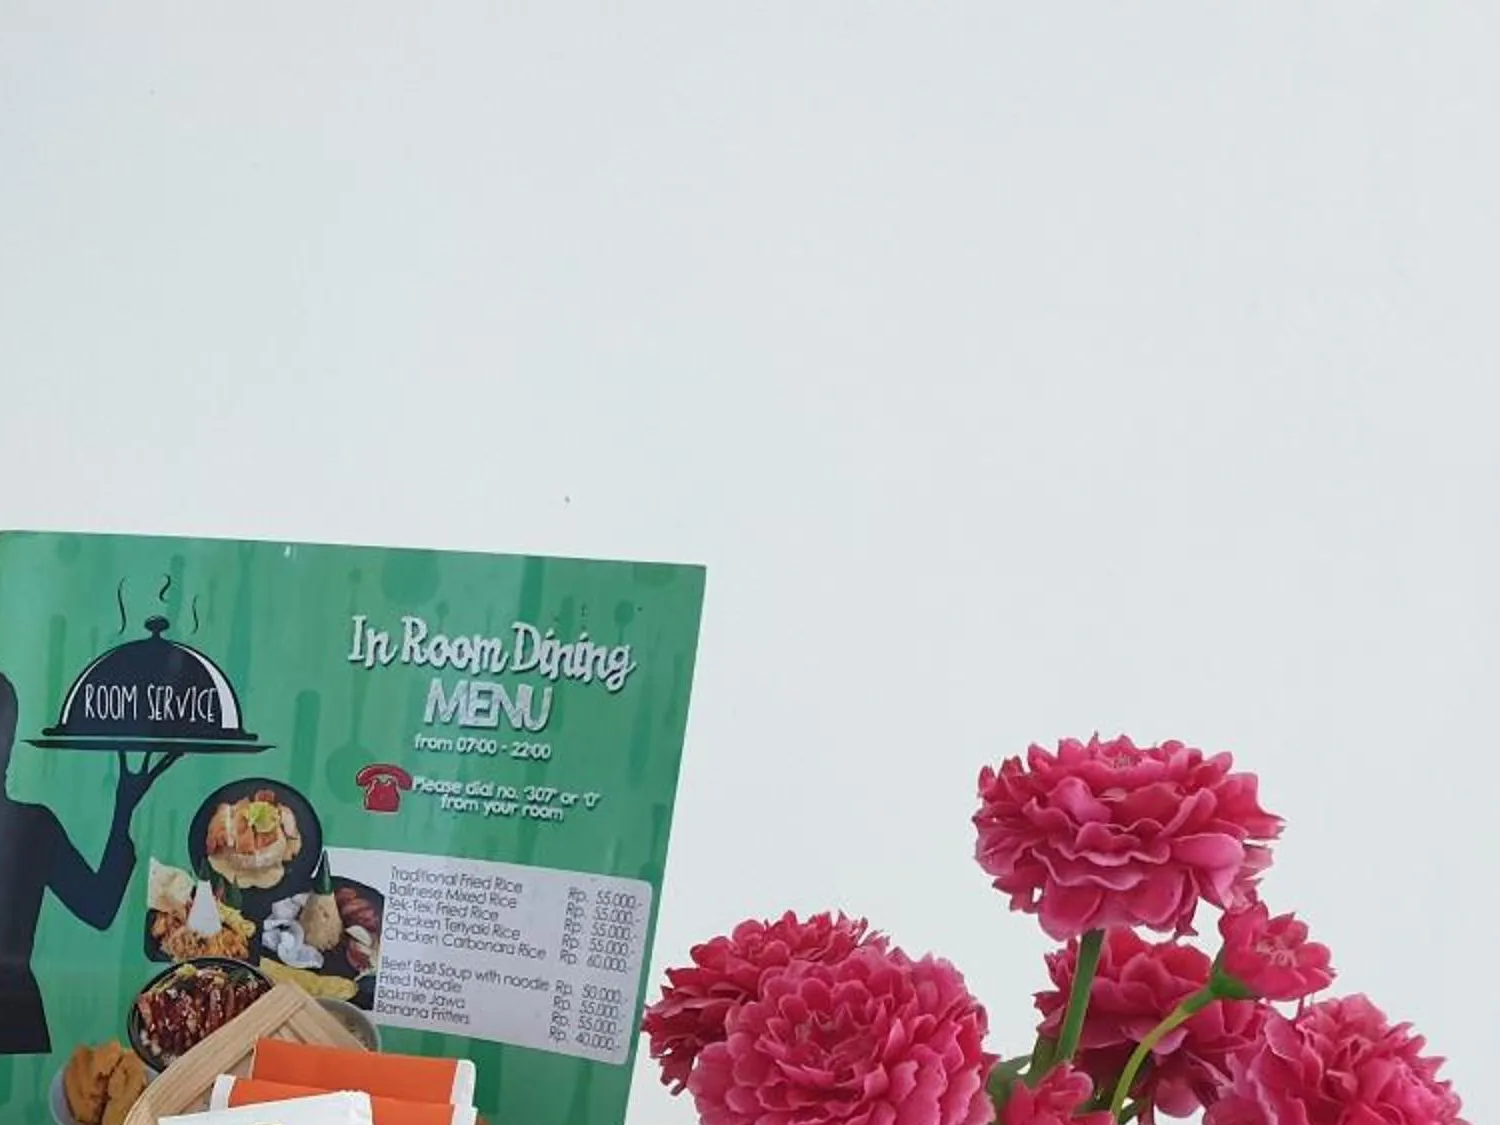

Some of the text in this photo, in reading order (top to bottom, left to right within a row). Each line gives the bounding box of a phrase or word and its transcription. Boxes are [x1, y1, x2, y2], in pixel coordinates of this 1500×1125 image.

[348, 614, 637, 693] In Room Dining
[85, 683, 217, 723] ROOM SERVICE
[423, 677, 553, 732] MENU
[414, 733, 453, 750] from
[412, 776, 463, 795] Please
[465, 780, 495, 797] dial
[560, 792, 579, 805] or
[440, 794, 564, 821] from your room
[390, 865, 458, 887] Traditional
[460, 873, 492, 890] Fried
[495, 876, 523, 894] Rice
[389, 881, 442, 899] Balinese
[445, 888, 486, 904] Mixed
[489, 891, 517, 908] Rice
[386, 911, 440, 930] Chicken
[445, 917, 490, 936] Teriyaki
[492, 923, 521, 940] Rice
[435, 901, 468, 918] Fried
[470, 905, 499, 921] Rice
[384, 926, 439, 946] Chicken
[441, 933, 516, 955] Carbonara
[518, 943, 547, 960] Rice
[379, 972, 411, 987] Fried
[413, 975, 462, 993] Noodle
[413, 959, 437, 975] Ball
[438, 963, 472, 982] Soup
[475, 969, 501, 984] with
[503, 975, 550, 992] noodle
[376, 1000, 429, 1019] Banana
[428, 992, 466, 1009] Jawa
